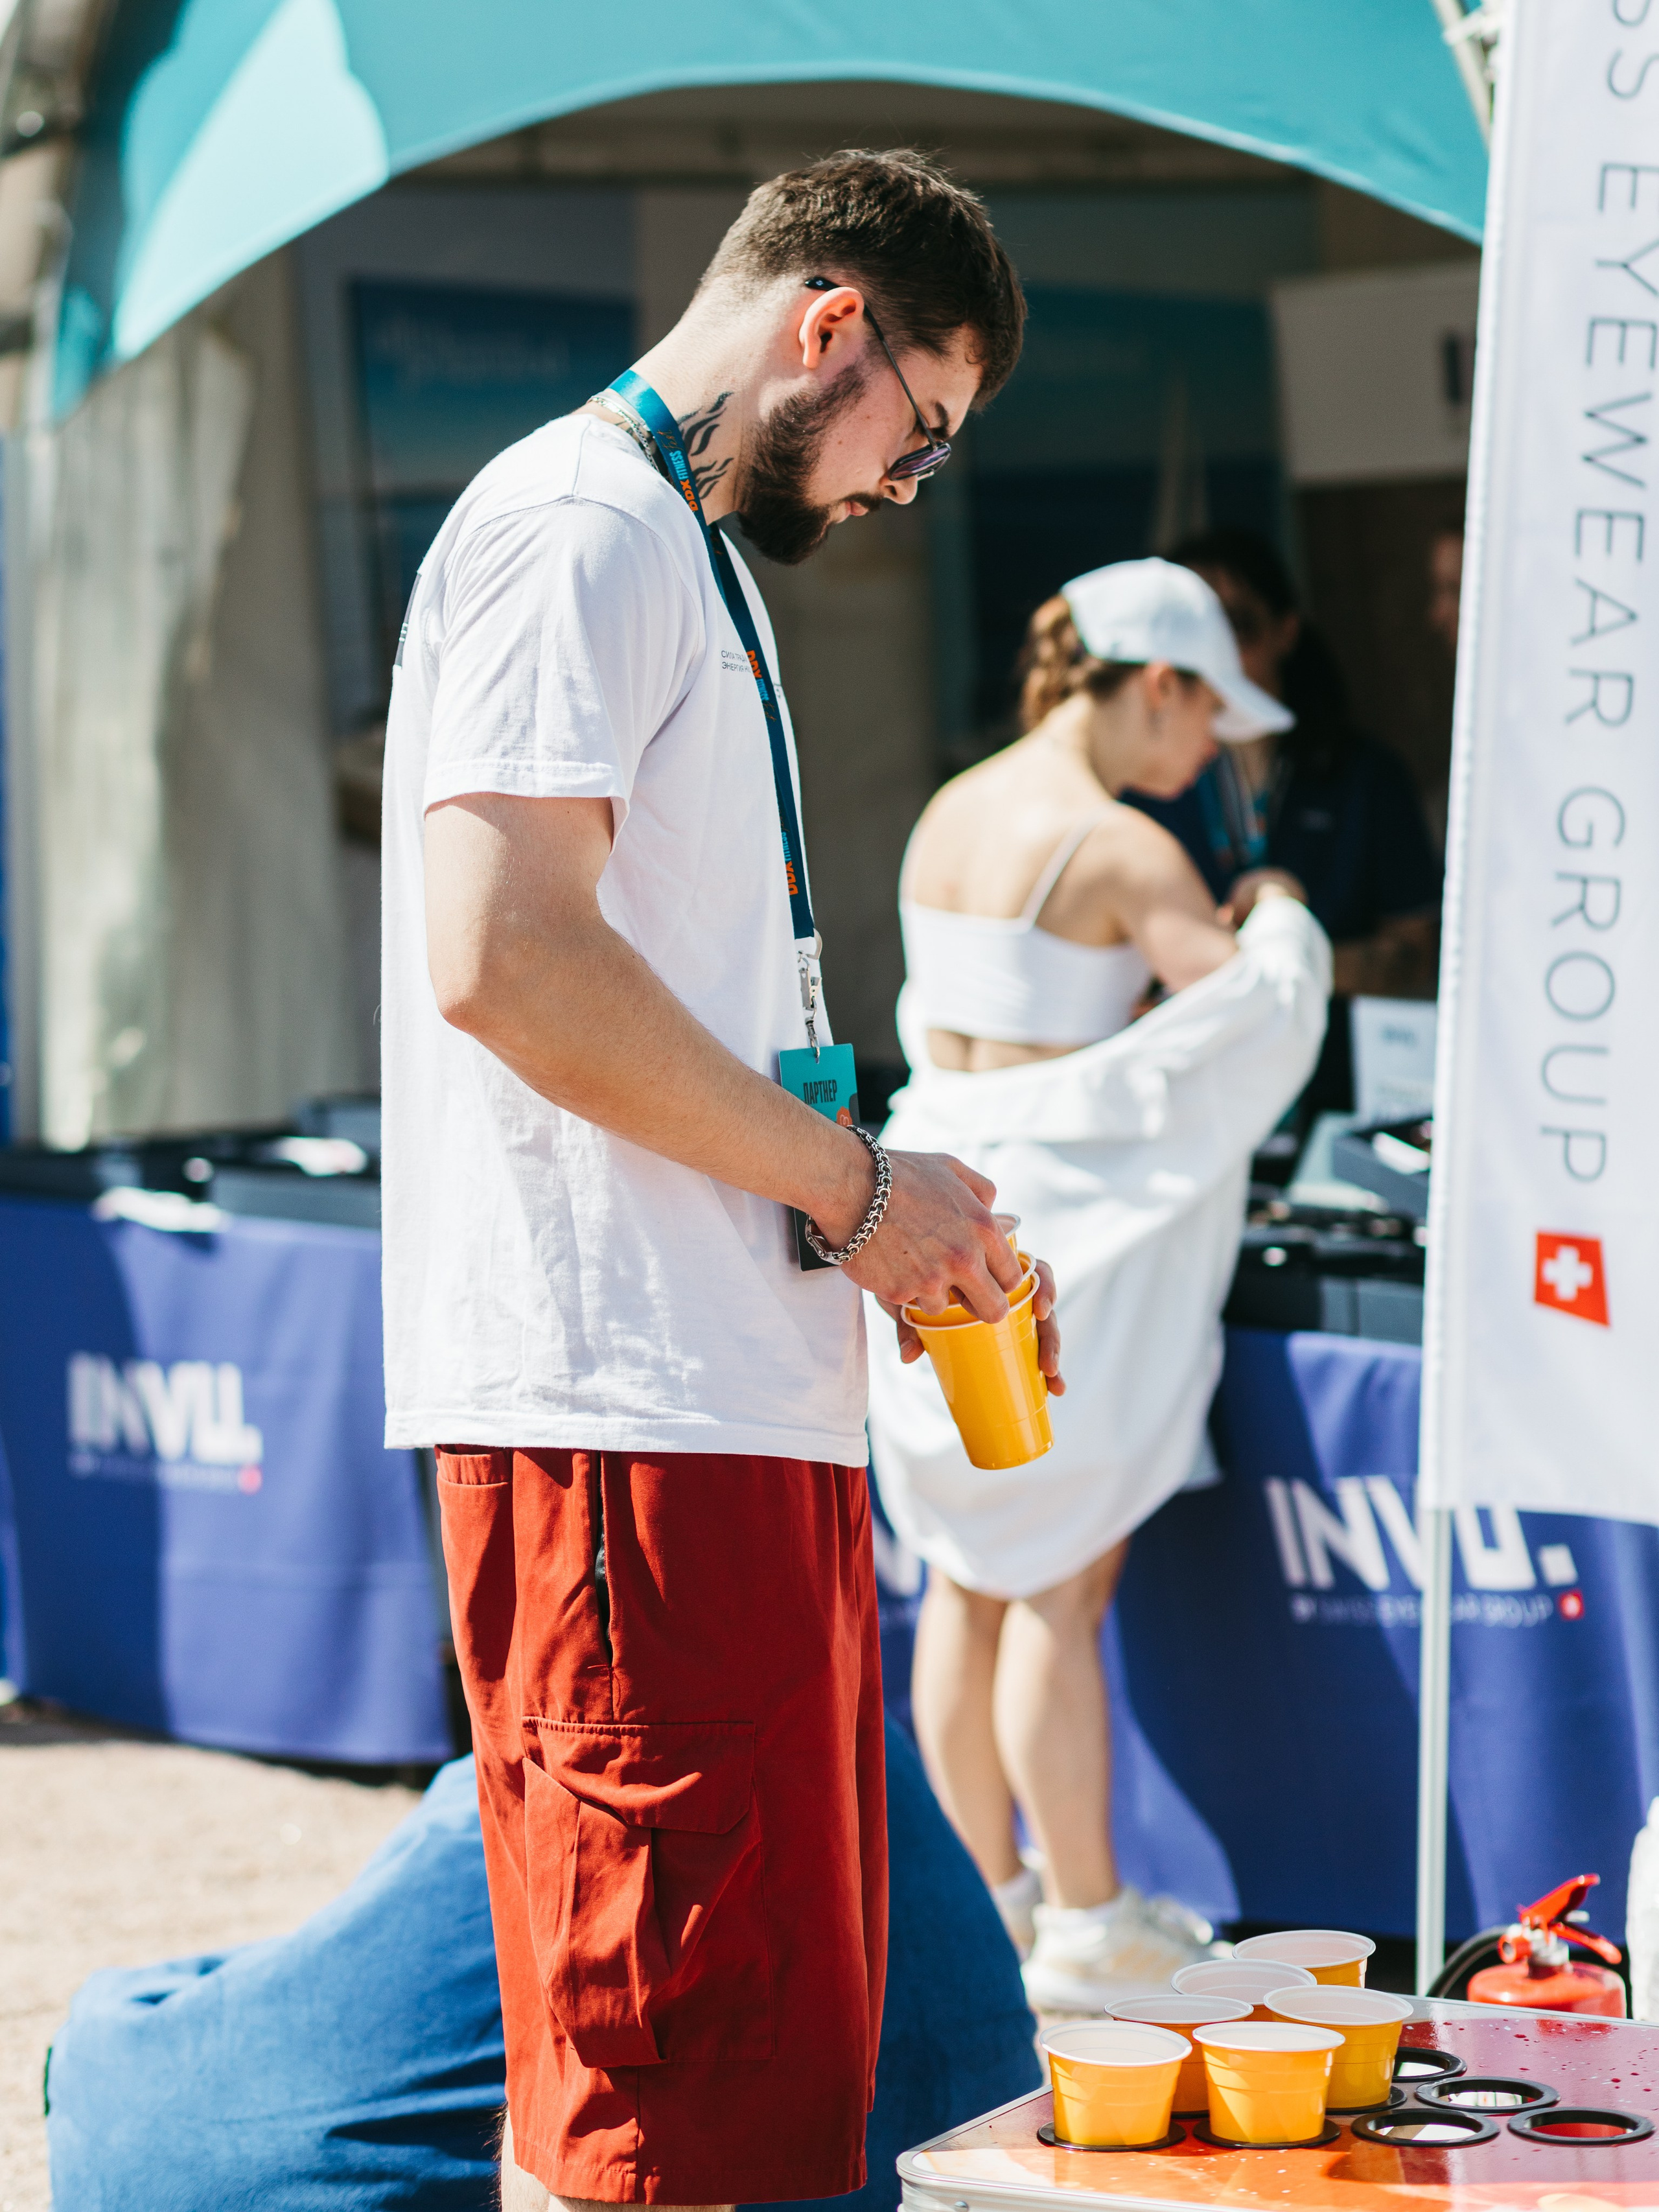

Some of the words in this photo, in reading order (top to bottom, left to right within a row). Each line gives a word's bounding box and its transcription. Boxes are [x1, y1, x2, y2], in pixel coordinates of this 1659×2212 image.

[1564, 161, 1659, 728] EYEWEAR
[669, 450, 689, 480] FITNESS
[680, 479, 699, 511] DDX
[1540, 786, 1626, 1183] GROUP
[803, 1079, 837, 1104] ПАРТНЕР
